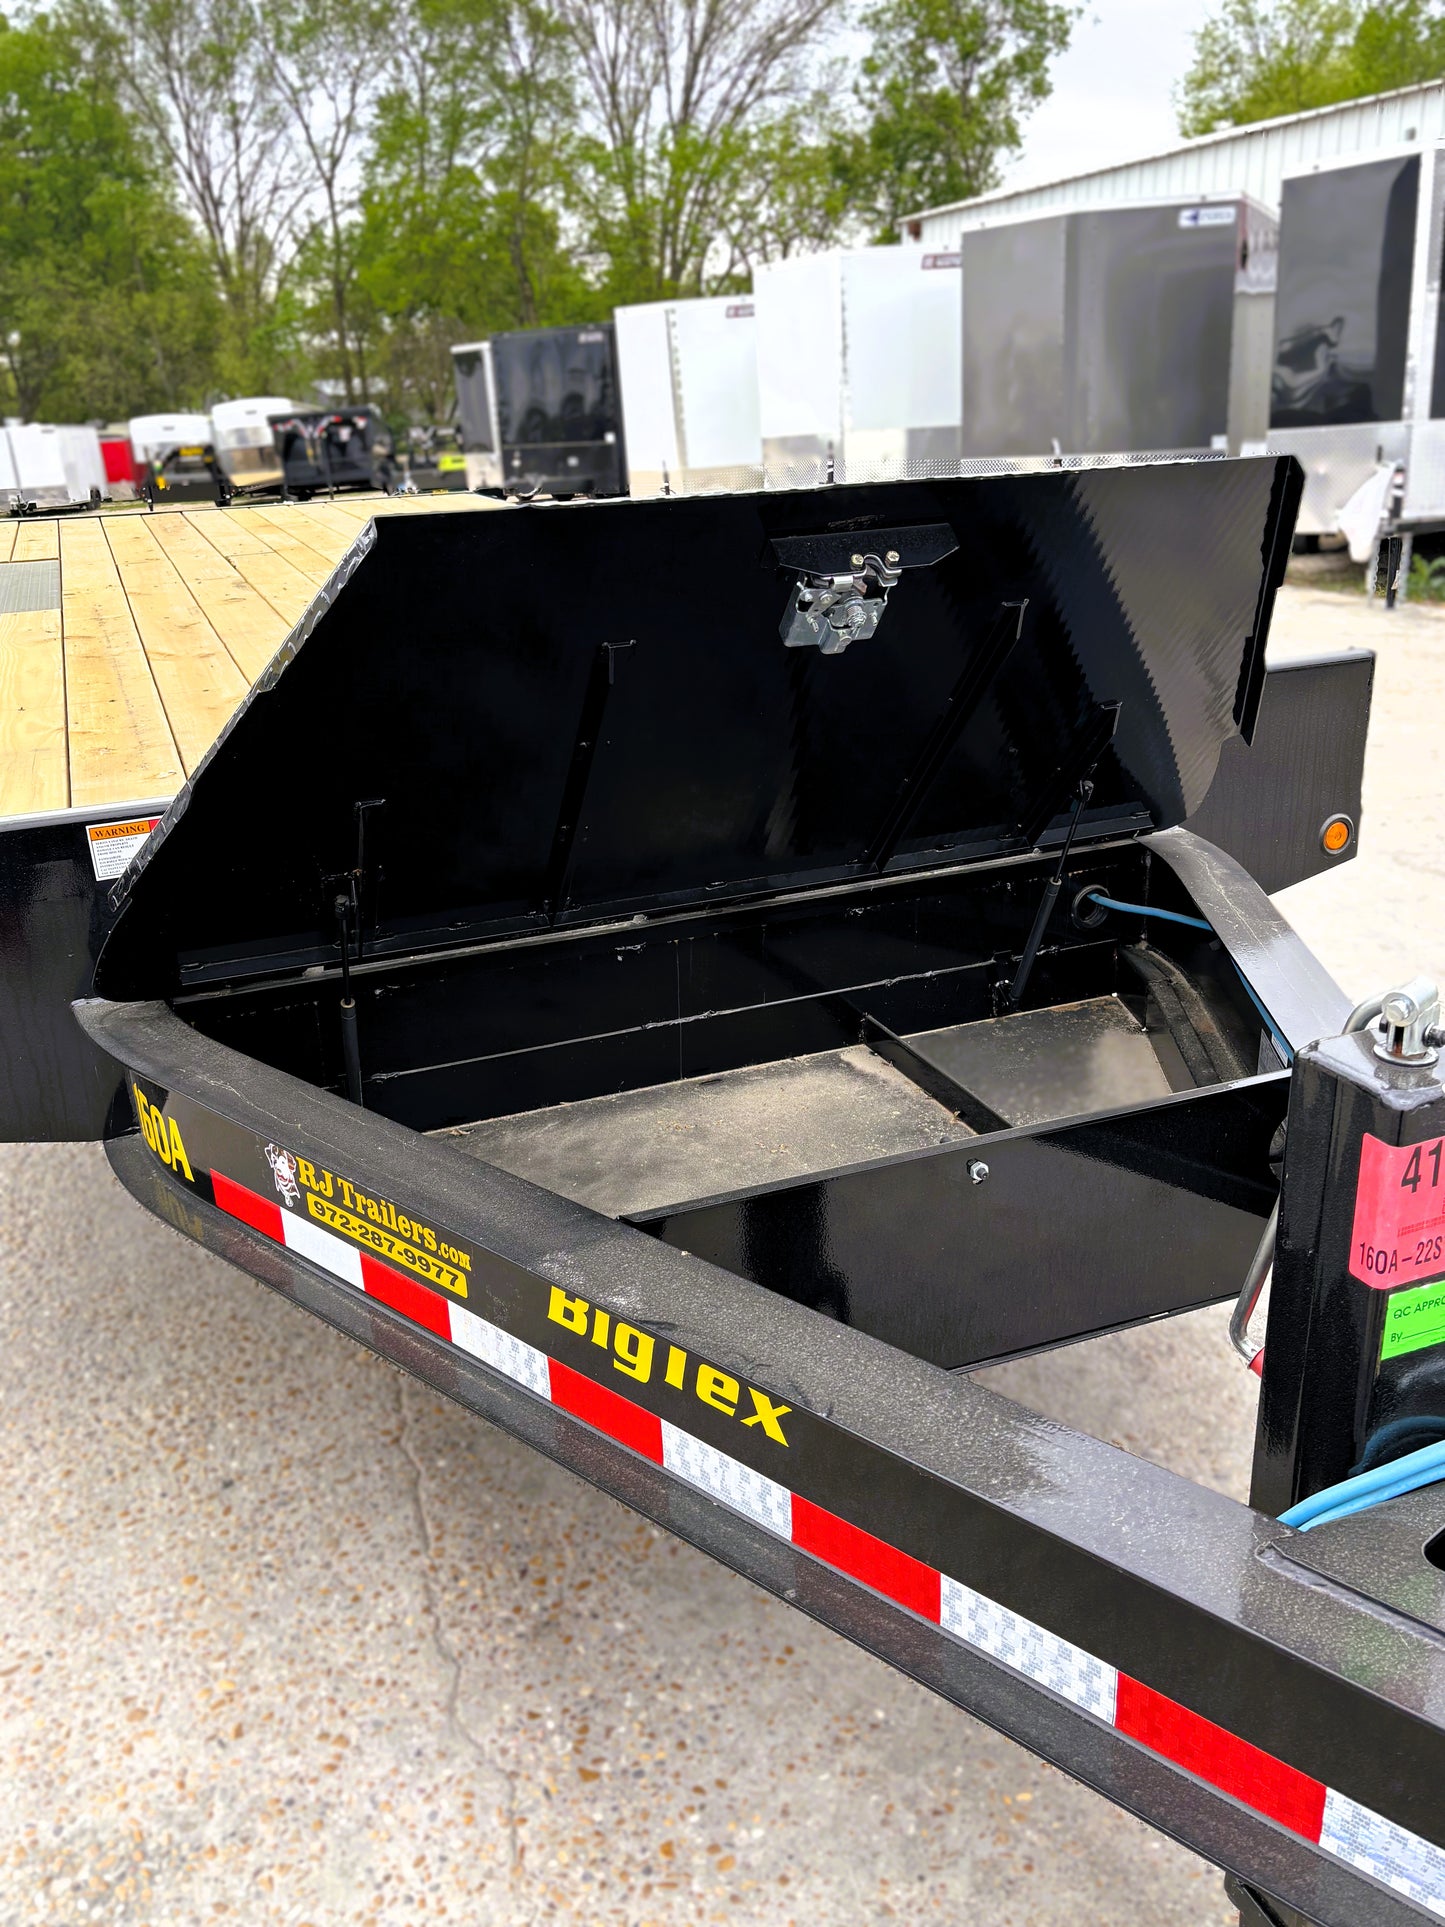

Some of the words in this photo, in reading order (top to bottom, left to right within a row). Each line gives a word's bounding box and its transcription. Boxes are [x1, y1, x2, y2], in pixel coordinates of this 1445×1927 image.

[94, 824, 145, 838] WARNING
[1401, 1139, 1444, 1193] 41
[296, 1156, 333, 1198] RJ
[338, 1177, 472, 1271] Trailers.com
[314, 1200, 459, 1287] 972-287-9977
[1360, 1235, 1445, 1275] 160A-22S
[1394, 1306, 1411, 1319] QC
